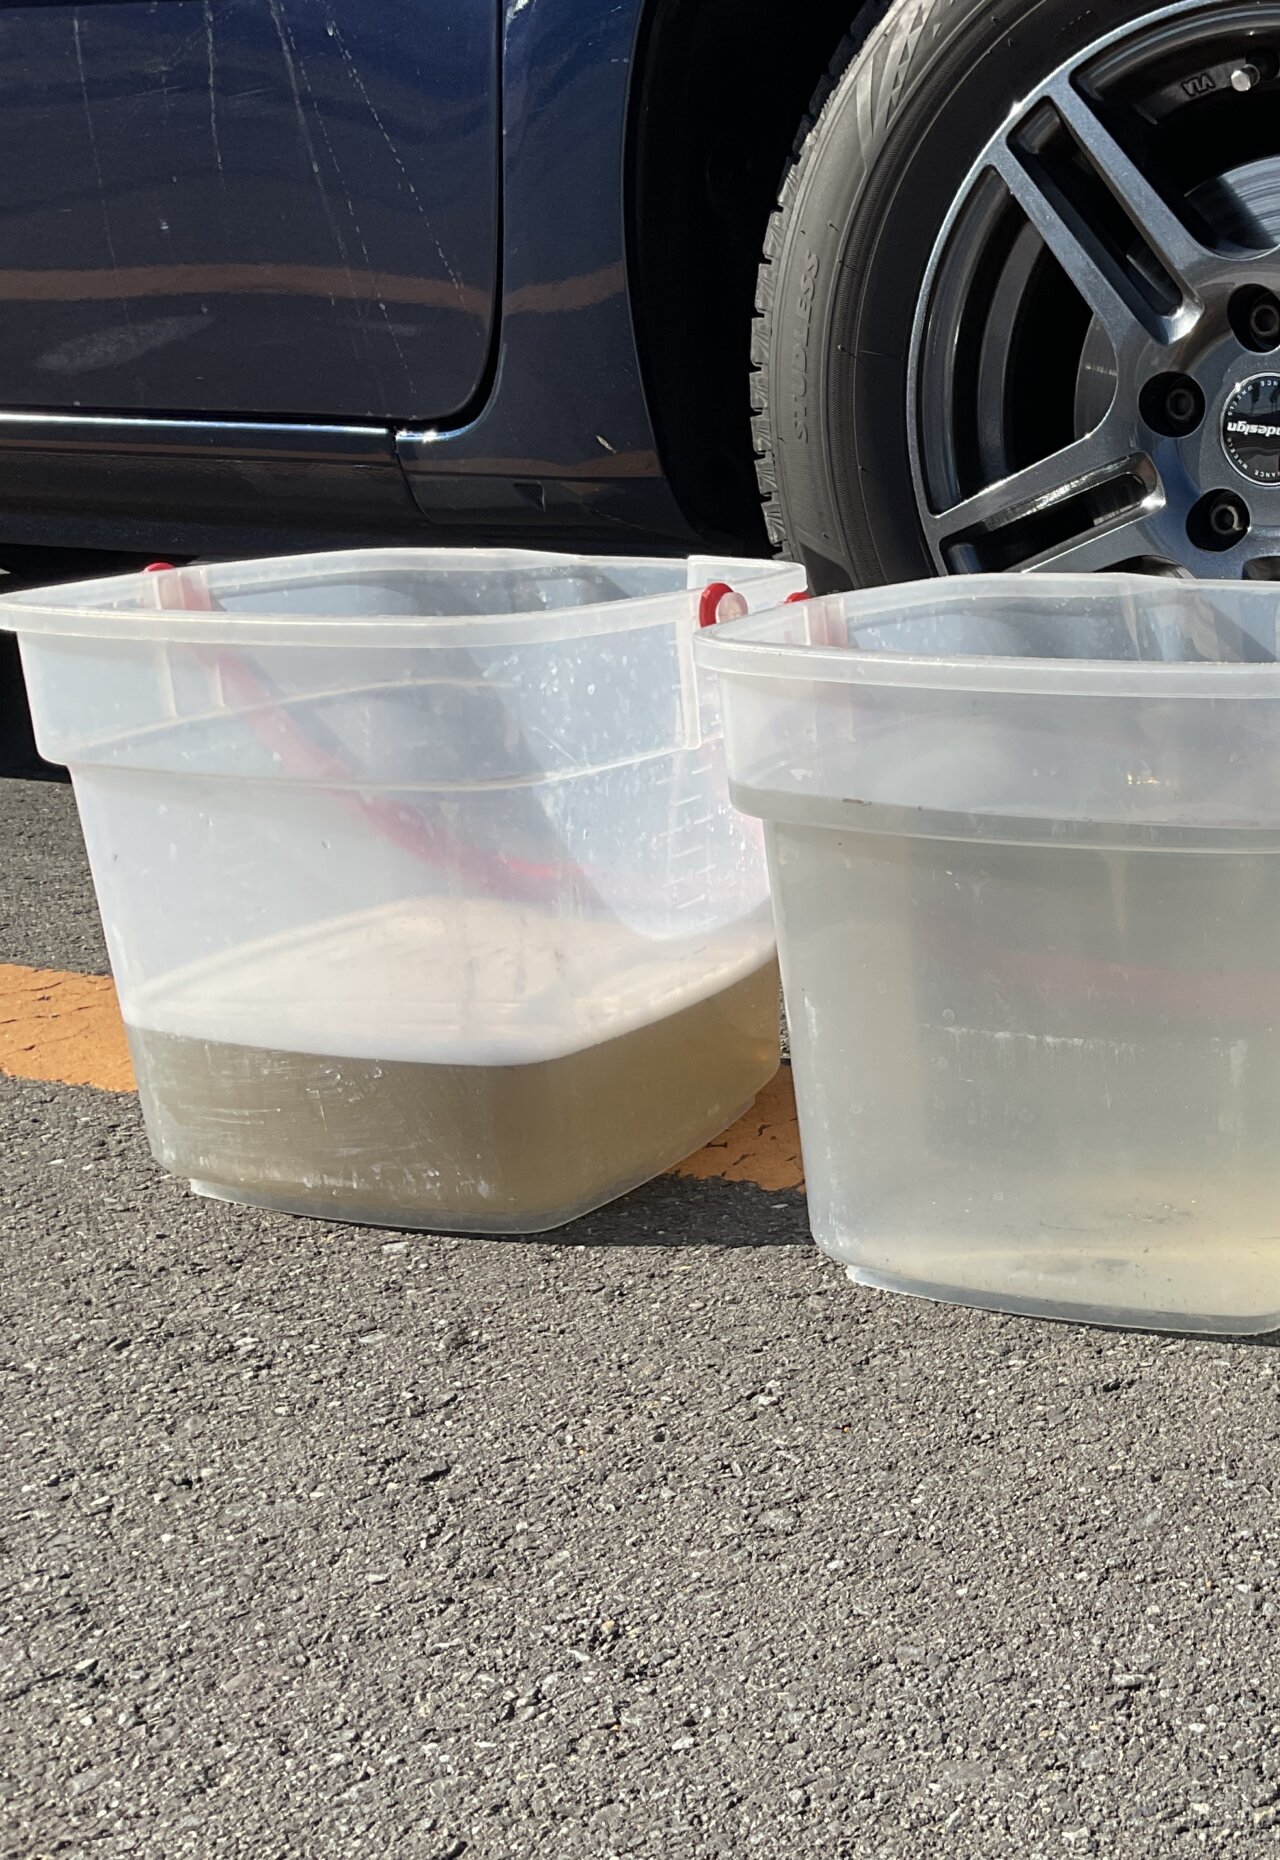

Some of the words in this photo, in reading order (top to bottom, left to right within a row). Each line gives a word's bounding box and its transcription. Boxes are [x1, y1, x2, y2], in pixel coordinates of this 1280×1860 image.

[792, 249, 820, 444] STUDLESS
[1227, 385, 1254, 416] WHEELS
[1226, 437, 1248, 470] WHEELS
